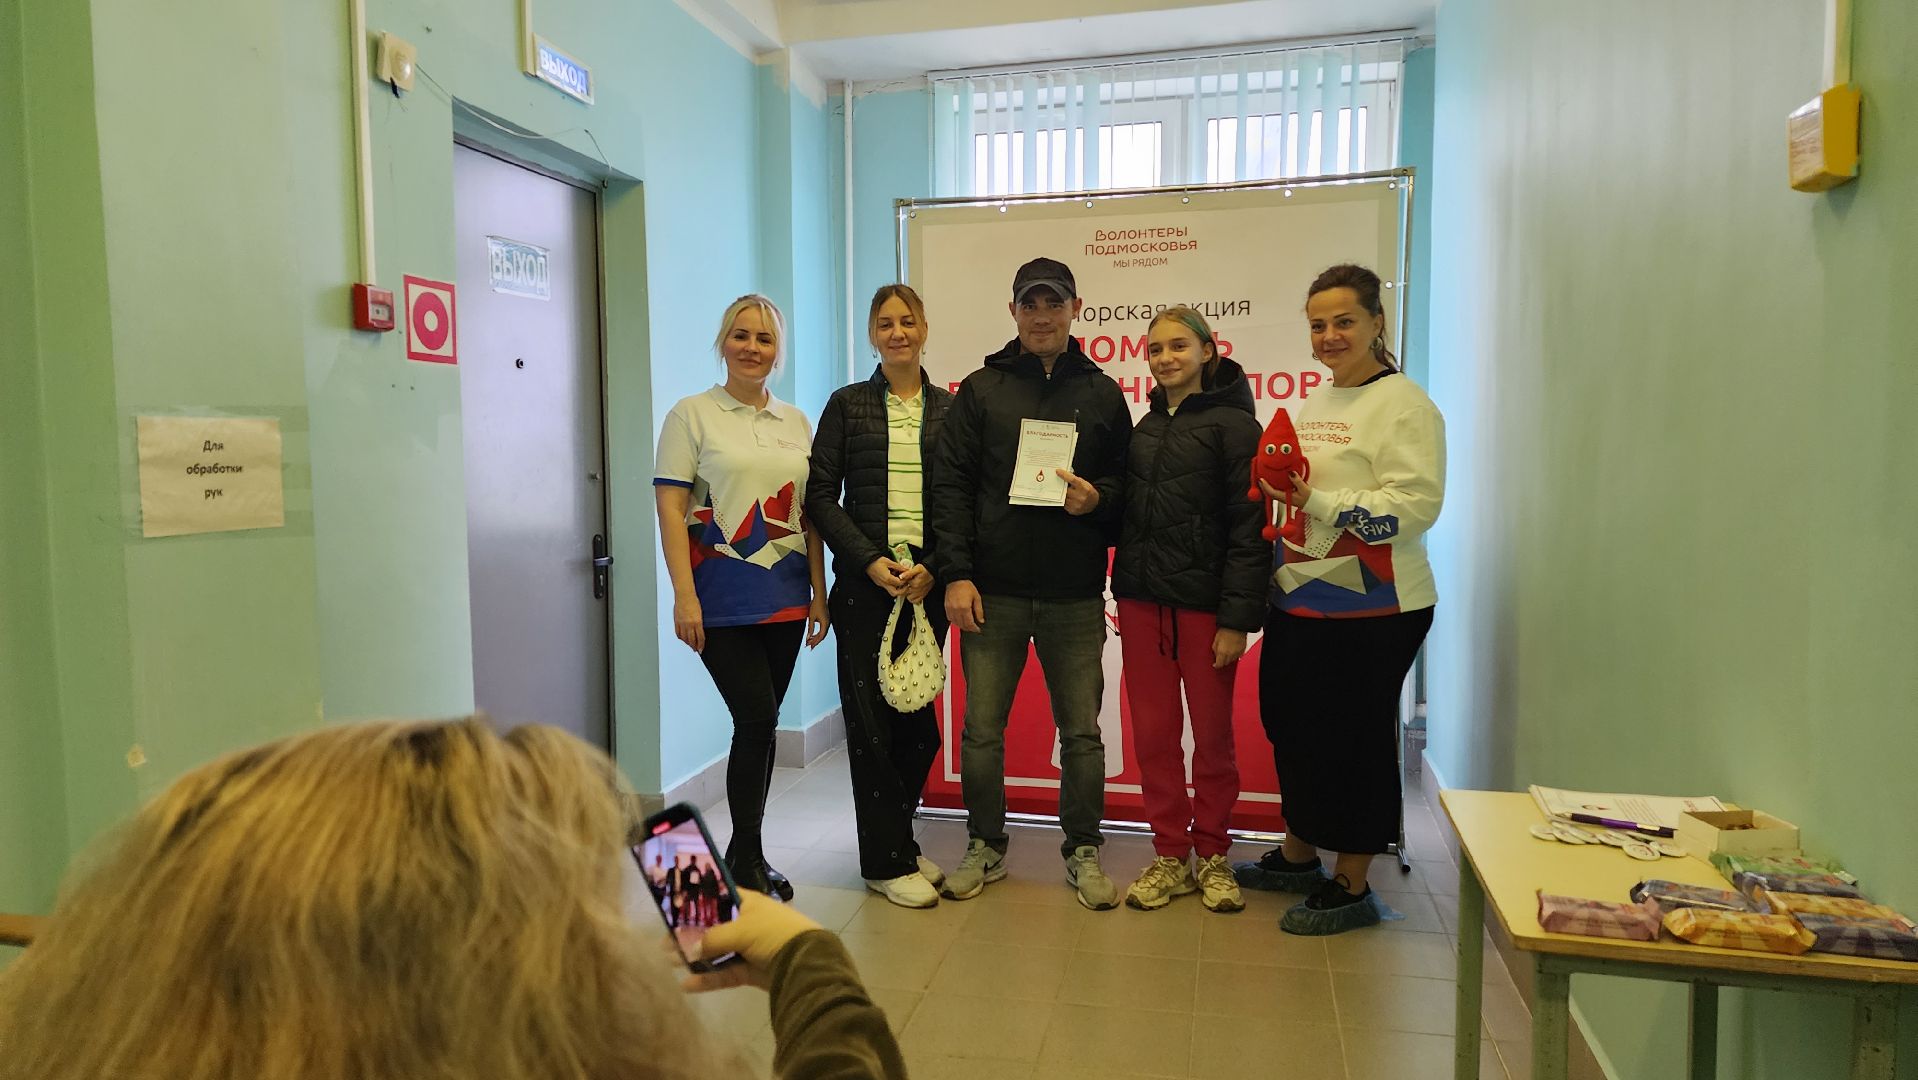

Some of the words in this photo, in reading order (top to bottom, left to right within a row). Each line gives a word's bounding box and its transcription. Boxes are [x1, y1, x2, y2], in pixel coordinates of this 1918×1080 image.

[540, 47, 588, 95] ВЫХОД
[1095, 226, 1188, 242] ВОЛОНТЕРЫ
[1085, 240, 1198, 256] ПОДМОСКОВЬЯ
[491, 246, 547, 296] ВЫХОД
[1113, 259, 1130, 269] МЫ
[1132, 257, 1168, 268] РЯДОМ
[1077, 303, 1168, 326] орская
[1177, 300, 1250, 320] кция
[203, 440, 224, 453] Для
[186, 463, 243, 477] обработки
[204, 488, 223, 500] рук
